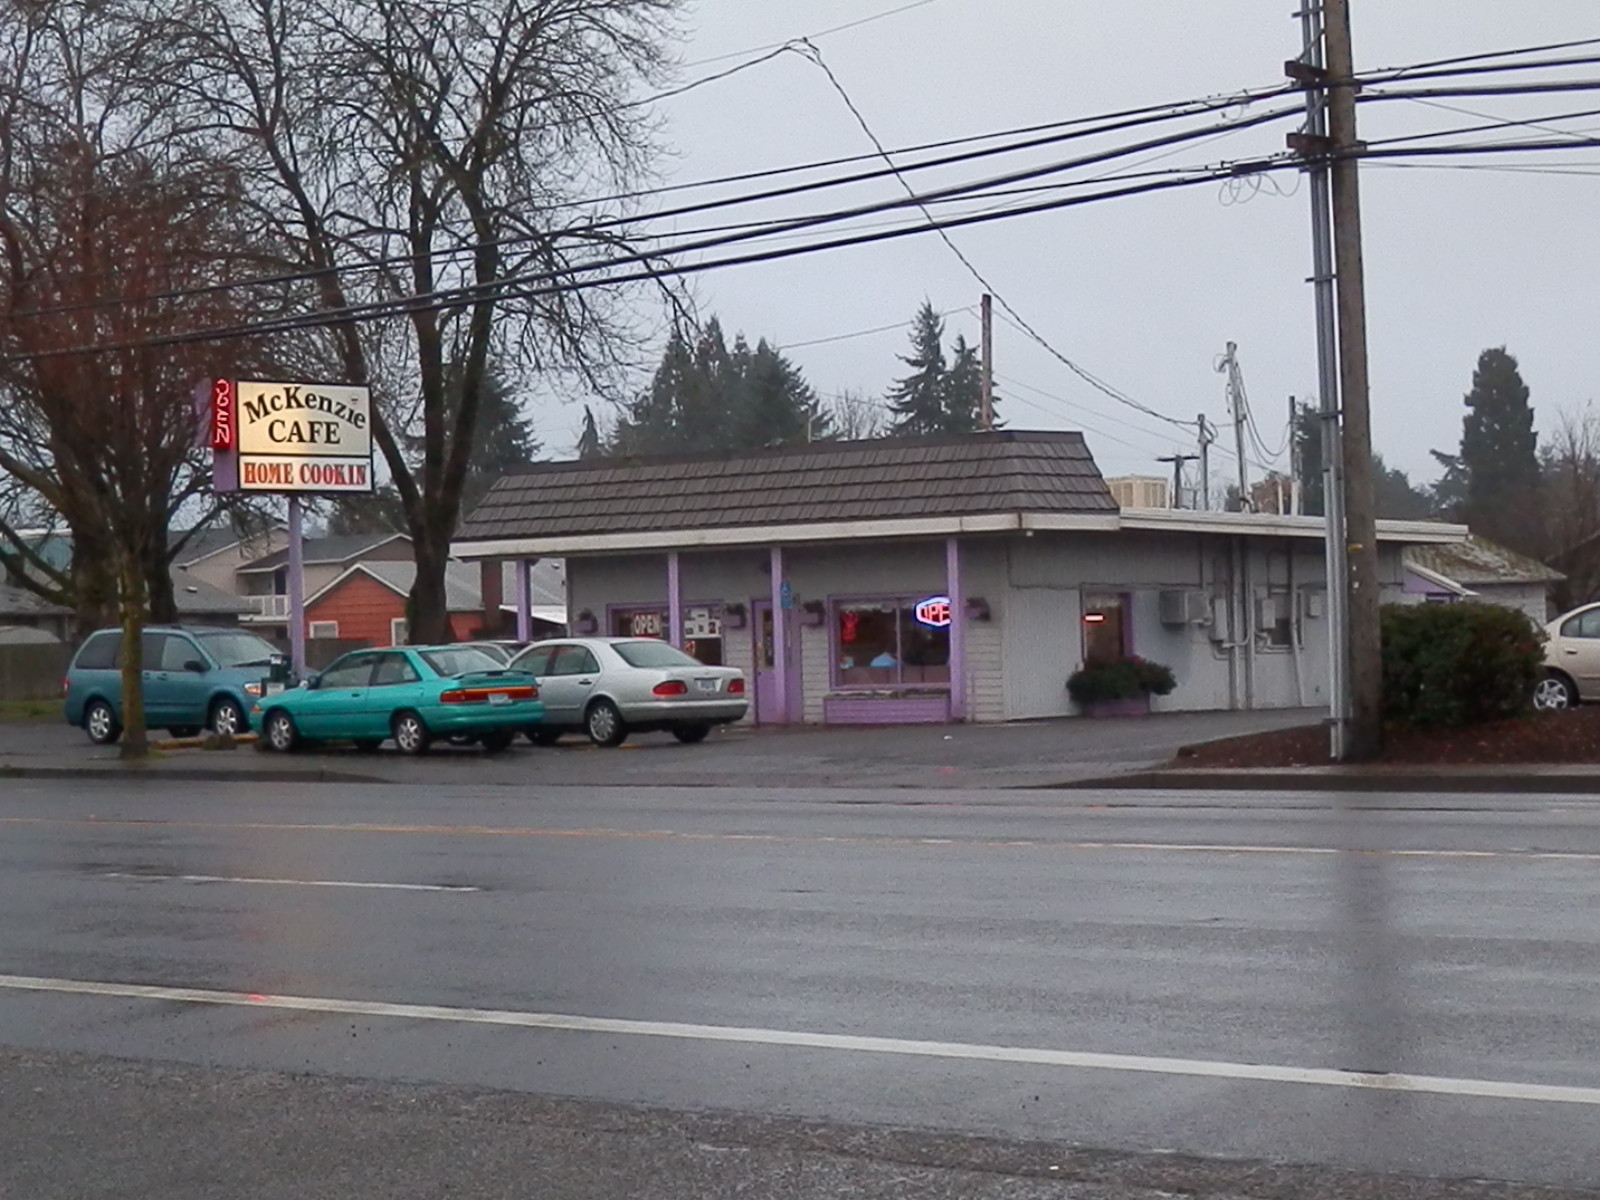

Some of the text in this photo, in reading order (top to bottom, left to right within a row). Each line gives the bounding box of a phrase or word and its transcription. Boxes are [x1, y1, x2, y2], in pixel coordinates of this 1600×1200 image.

[214, 378, 230, 444] OPEN
[243, 386, 366, 429] McKenzie
[268, 419, 341, 445] CAFE
[244, 462, 293, 485] HOME
[633, 613, 661, 635] OPEN
[918, 603, 950, 623] OPE
